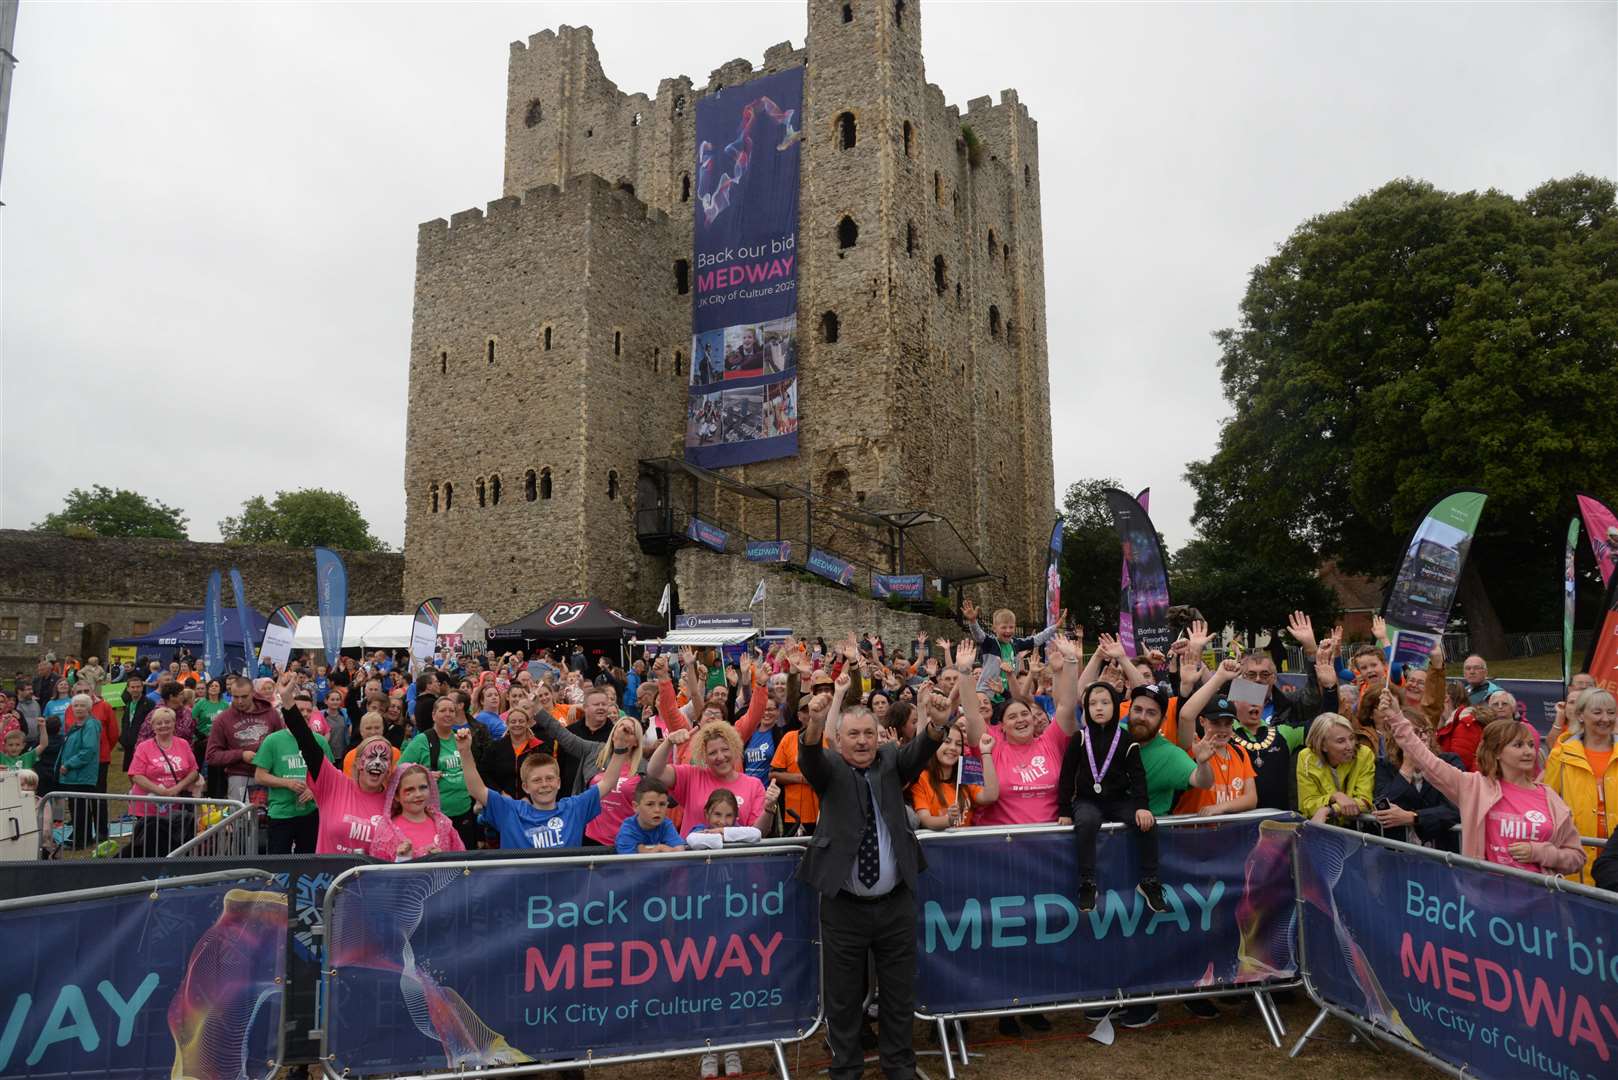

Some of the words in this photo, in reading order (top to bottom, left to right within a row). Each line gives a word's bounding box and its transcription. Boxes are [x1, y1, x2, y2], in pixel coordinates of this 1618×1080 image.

[698, 247, 733, 268] Back
[738, 244, 766, 259] our
[771, 233, 795, 254] bid
[697, 256, 795, 293] MEDWAY
[709, 292, 726, 307] City
[727, 288, 737, 301] of
[739, 285, 773, 299] Culture
[775, 280, 795, 293] 2025
[747, 548, 780, 557] MEDWAY
[747, 751, 767, 764] MILE
[1020, 765, 1049, 784] MILE
[349, 822, 372, 842] MIL
[532, 828, 564, 849] MILE
[1500, 818, 1541, 842] MILE
[527, 890, 628, 930] Back
[642, 893, 711, 924] our
[724, 881, 785, 918] bid
[923, 880, 1225, 954] MEDWAY
[1406, 879, 1477, 937] Back
[1488, 916, 1557, 960] our
[523, 931, 783, 993] MEDWAY
[524, 1005, 558, 1026] UK
[565, 1002, 609, 1027] City
[615, 998, 639, 1020] of
[646, 993, 723, 1018] Culture
[730, 988, 783, 1009] 2025
[1408, 992, 1434, 1022] UK
[1437, 1006, 1475, 1042] City
[1481, 1022, 1501, 1048] of
[1504, 1035, 1581, 1080] Culture
